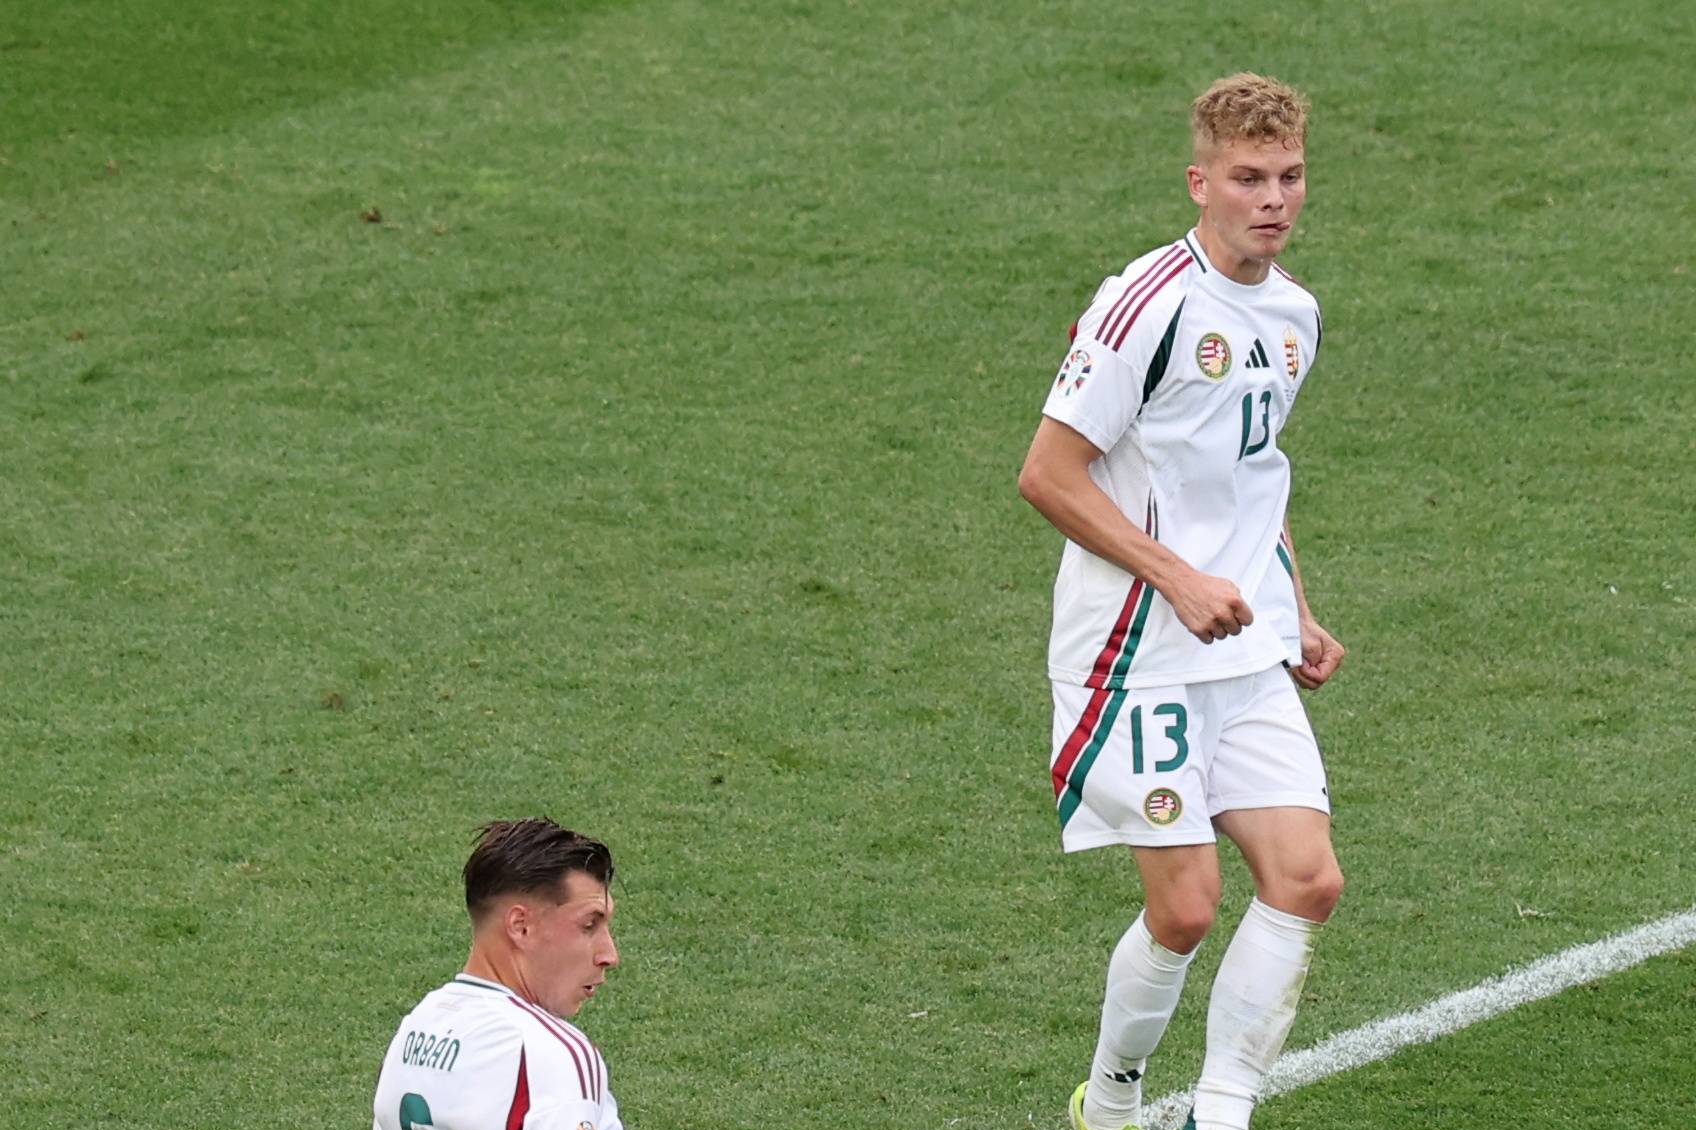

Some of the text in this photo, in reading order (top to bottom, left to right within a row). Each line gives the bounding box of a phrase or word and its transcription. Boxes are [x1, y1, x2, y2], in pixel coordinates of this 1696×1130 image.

[1238, 390, 1272, 461] 13
[1130, 702, 1189, 774] 13
[402, 1028, 461, 1072] ORBÁN
